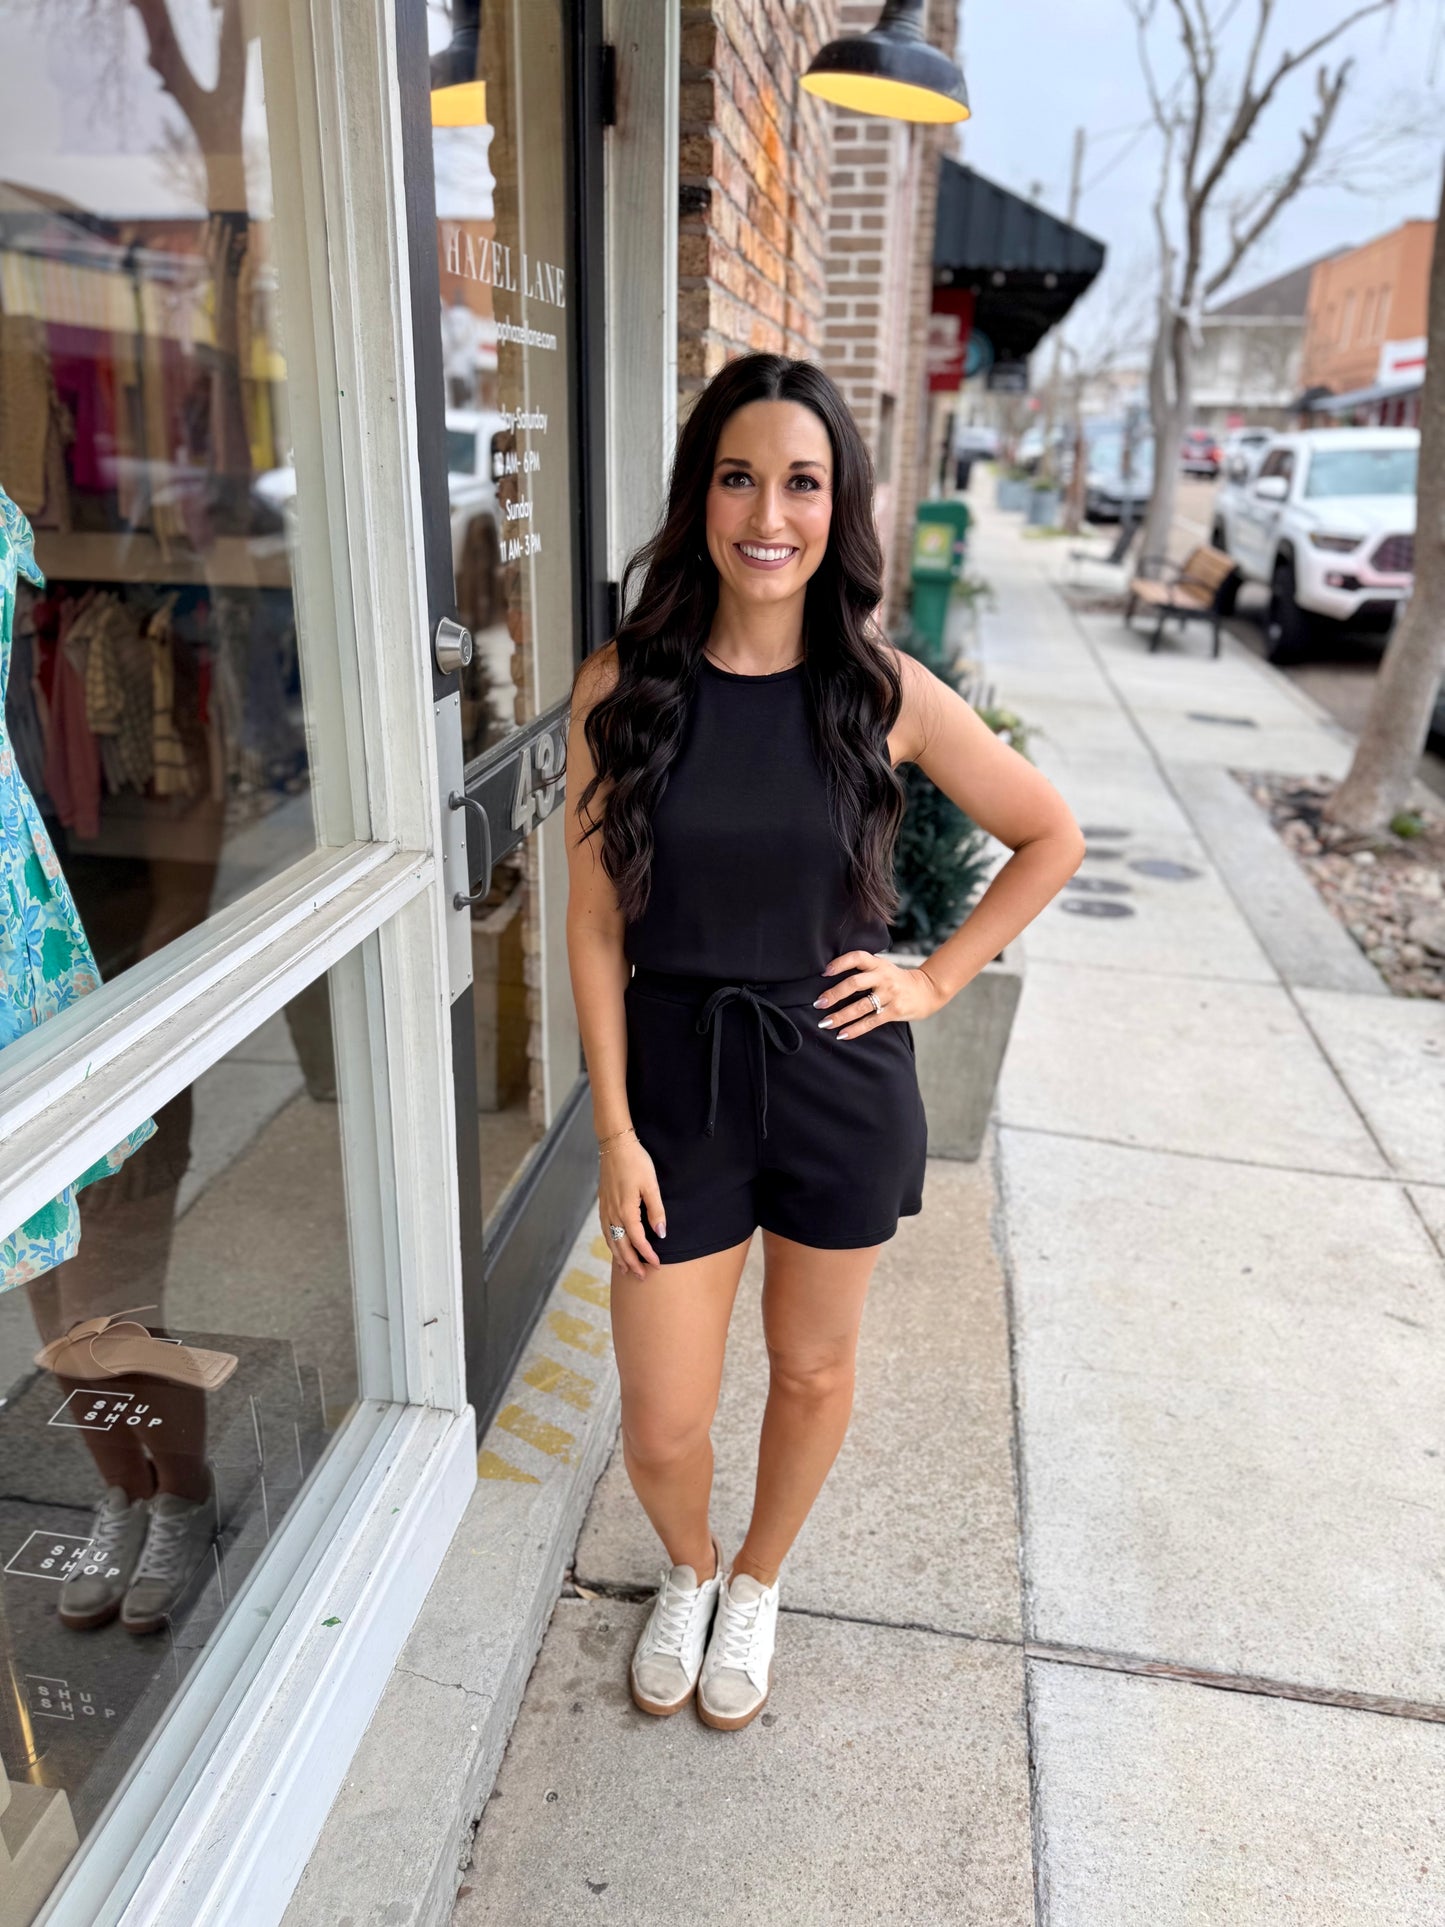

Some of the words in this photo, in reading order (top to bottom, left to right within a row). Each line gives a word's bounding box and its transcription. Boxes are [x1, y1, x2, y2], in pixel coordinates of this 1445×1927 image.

[446, 223, 516, 292] HAZEL
[521, 253, 566, 309] LANE
[505, 493, 533, 522] Sunday
[93, 1400, 149, 1414] SHU
[84, 1411, 163, 1428] SHOP
[50, 1545, 109, 1562] SHU
[40, 1557, 120, 1578] SHOP
[38, 1685, 92, 1703] SHU
[41, 1697, 116, 1718] SHOP
